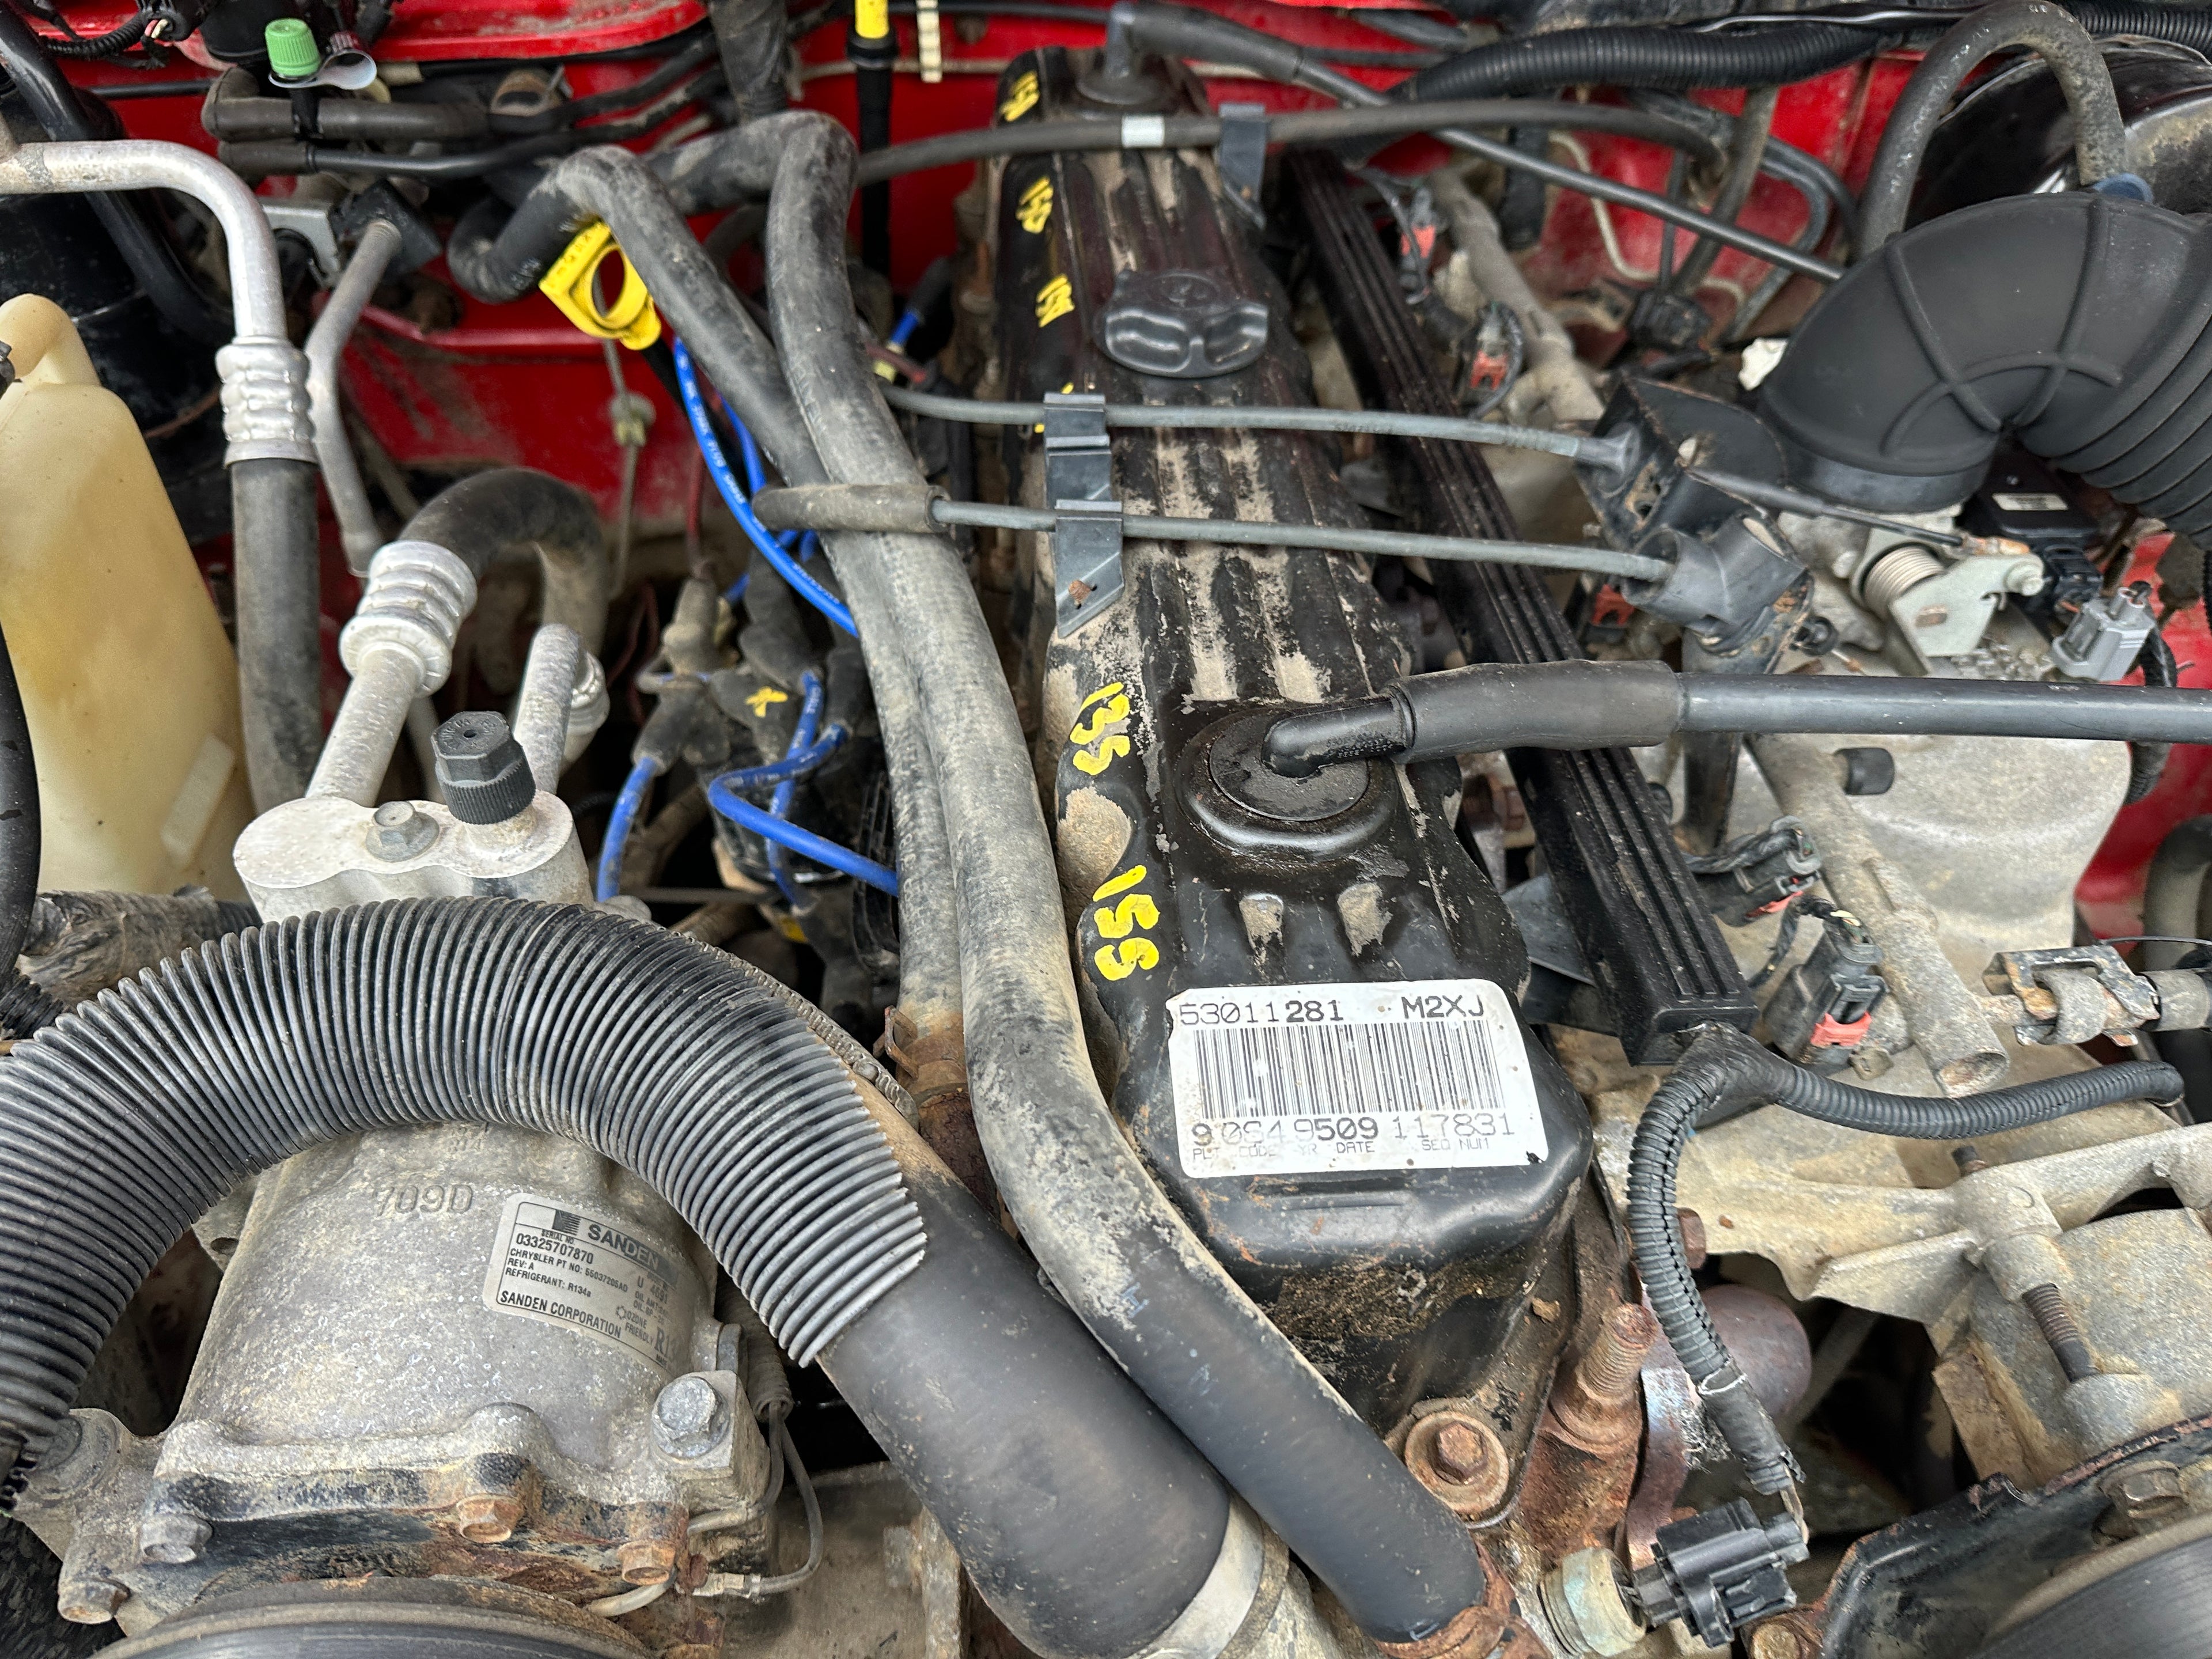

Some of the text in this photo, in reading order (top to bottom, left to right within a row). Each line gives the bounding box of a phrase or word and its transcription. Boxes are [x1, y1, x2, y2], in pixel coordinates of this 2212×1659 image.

[1093, 865, 1160, 981] 155
[1179, 994, 1484, 1025] 53011281 M2XJ
[1294, 1116, 1378, 1142] 9509
[1393, 1112, 1514, 1139] 117831
[1336, 1141, 1375, 1153] DATE
[1422, 1138, 1450, 1151] SEQ
[1459, 1137, 1489, 1150] NUM
[516, 1233, 594, 1264] 03325707870
[541, 1229, 562, 1241] SERIAL
[588, 1224, 659, 1271] SANDEN
[507, 1257, 535, 1270] REV: A
[510, 1248, 554, 1265] CHRYSLER
[556, 1259, 567, 1268] PT
[569, 1262, 583, 1274] NO:
[505, 1267, 592, 1297] REFRIGERANT: R134a
[637, 1275, 644, 1288] U
[500, 1290, 622, 1338] SANDEN CORPORATION
[627, 1310, 647, 1329] OZONE
[625, 1322, 654, 1346] FRIENDLY
